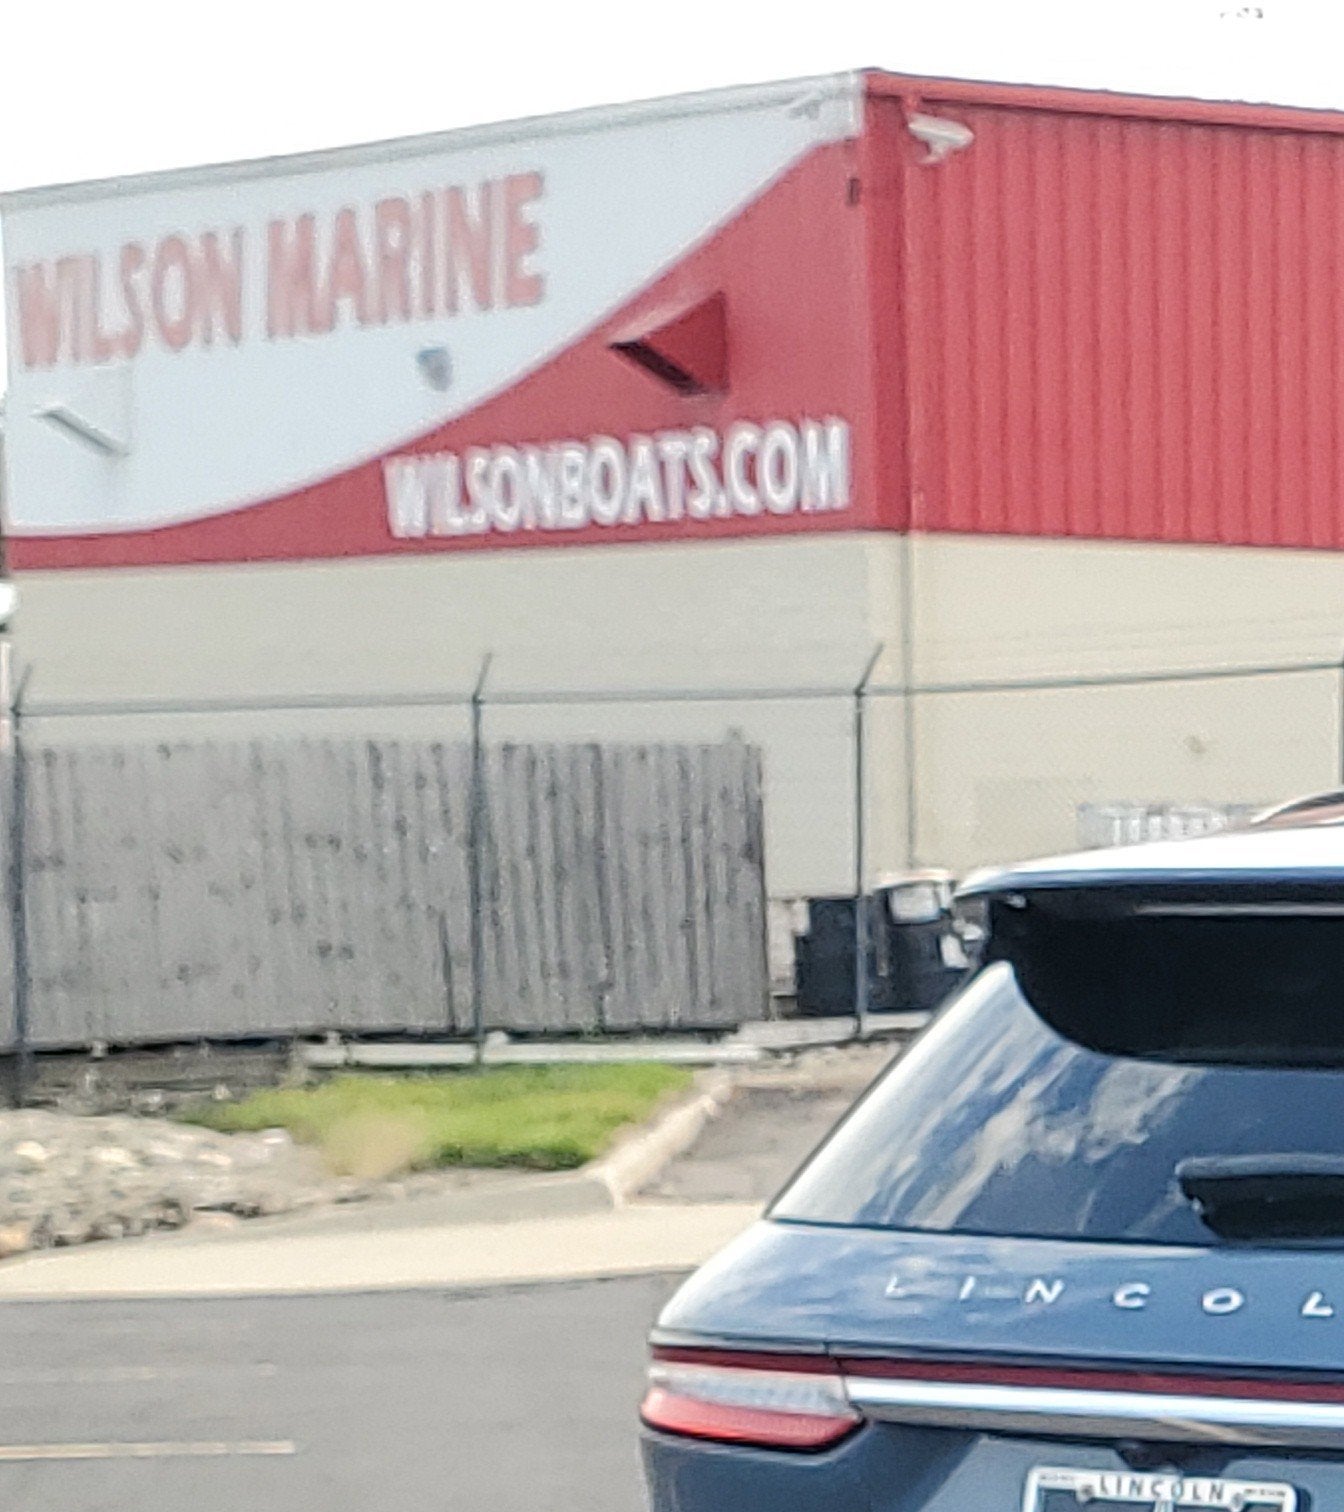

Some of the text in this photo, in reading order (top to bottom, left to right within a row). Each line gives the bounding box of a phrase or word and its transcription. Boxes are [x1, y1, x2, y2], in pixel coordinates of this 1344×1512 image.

[15, 169, 548, 369] WILSON MARINE
[383, 415, 852, 539] WILSONBOATS.COM
[1099, 1477, 1225, 1501] LINCOLN
